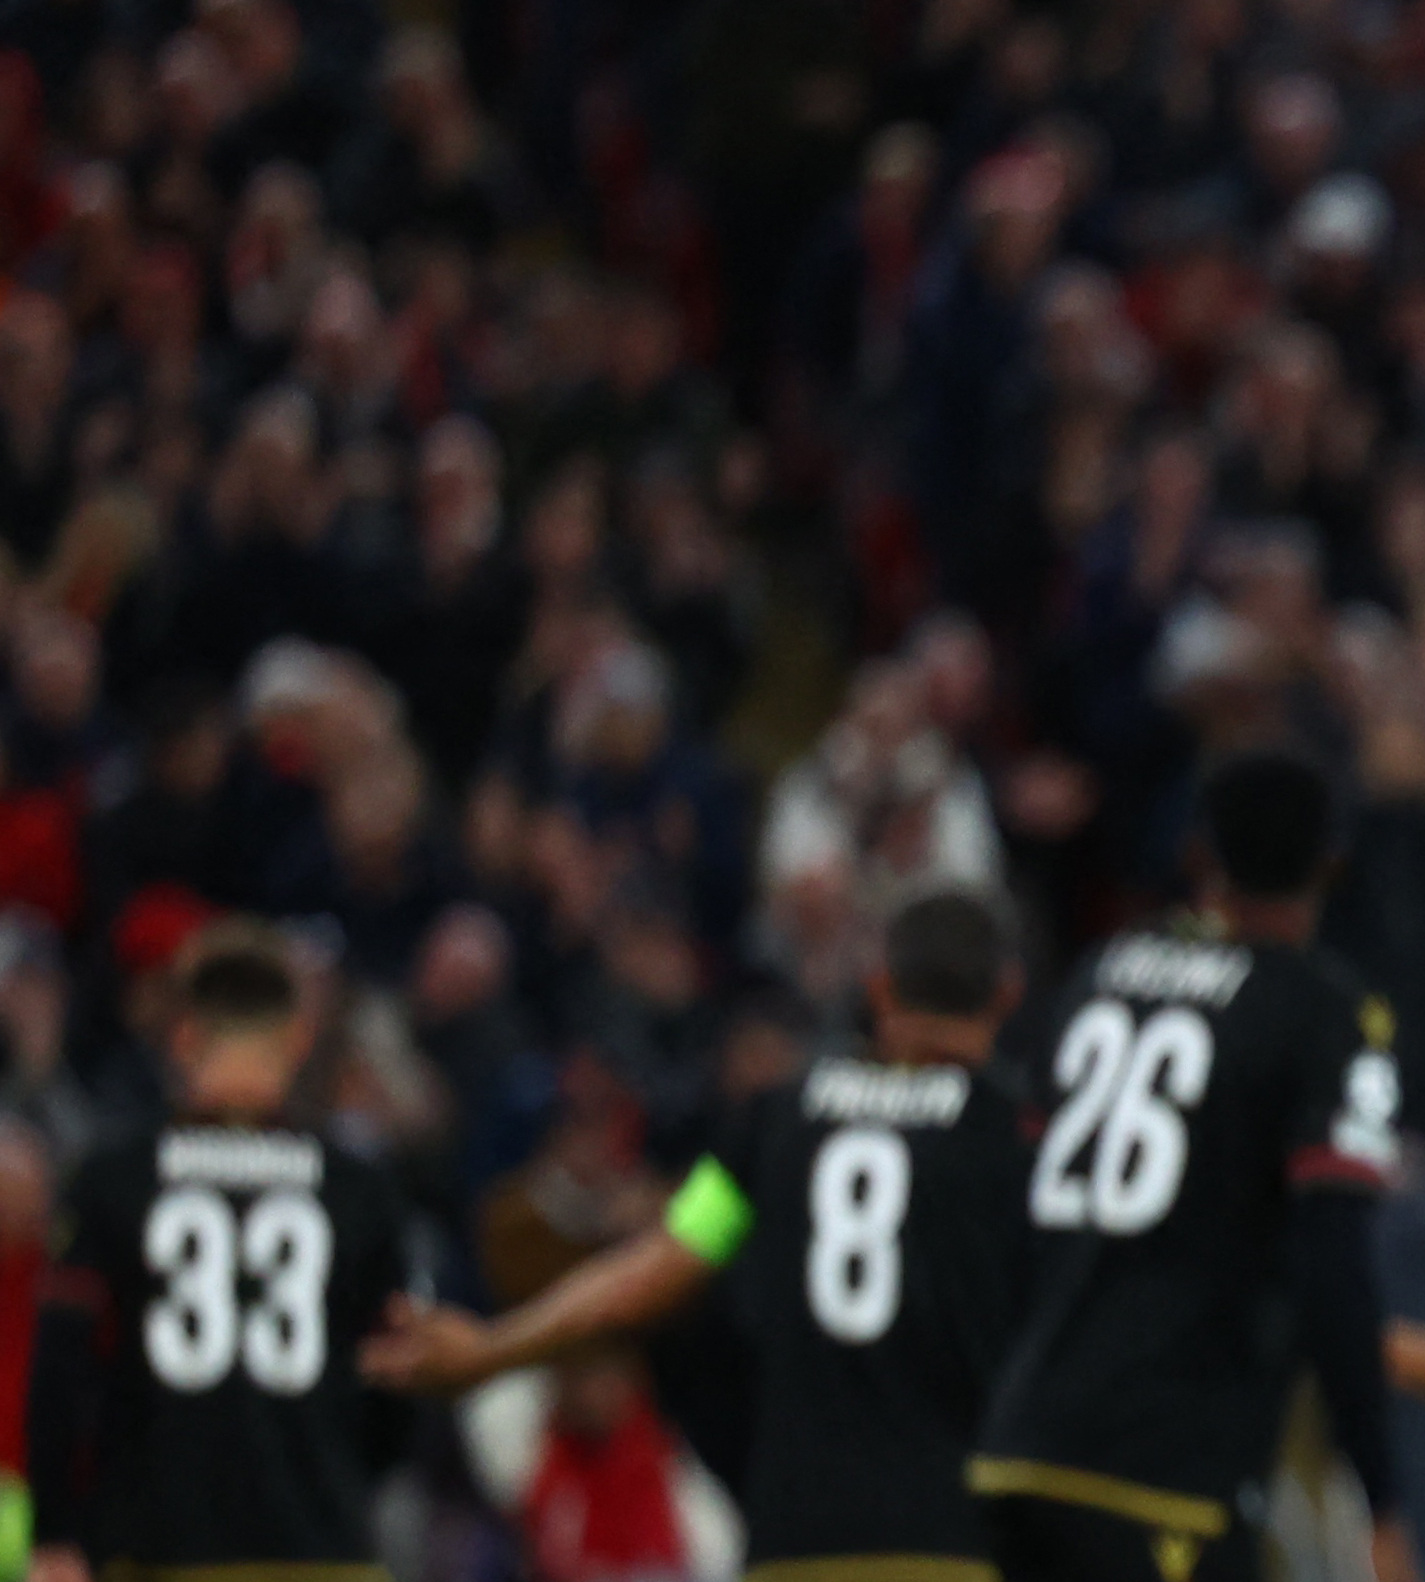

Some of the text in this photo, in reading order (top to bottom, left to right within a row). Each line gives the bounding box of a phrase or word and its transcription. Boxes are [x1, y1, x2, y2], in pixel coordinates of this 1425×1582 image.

[1028, 999, 1214, 1234] 26
[143, 1187, 333, 1392] 33
[806, 1125, 911, 1344] 8
